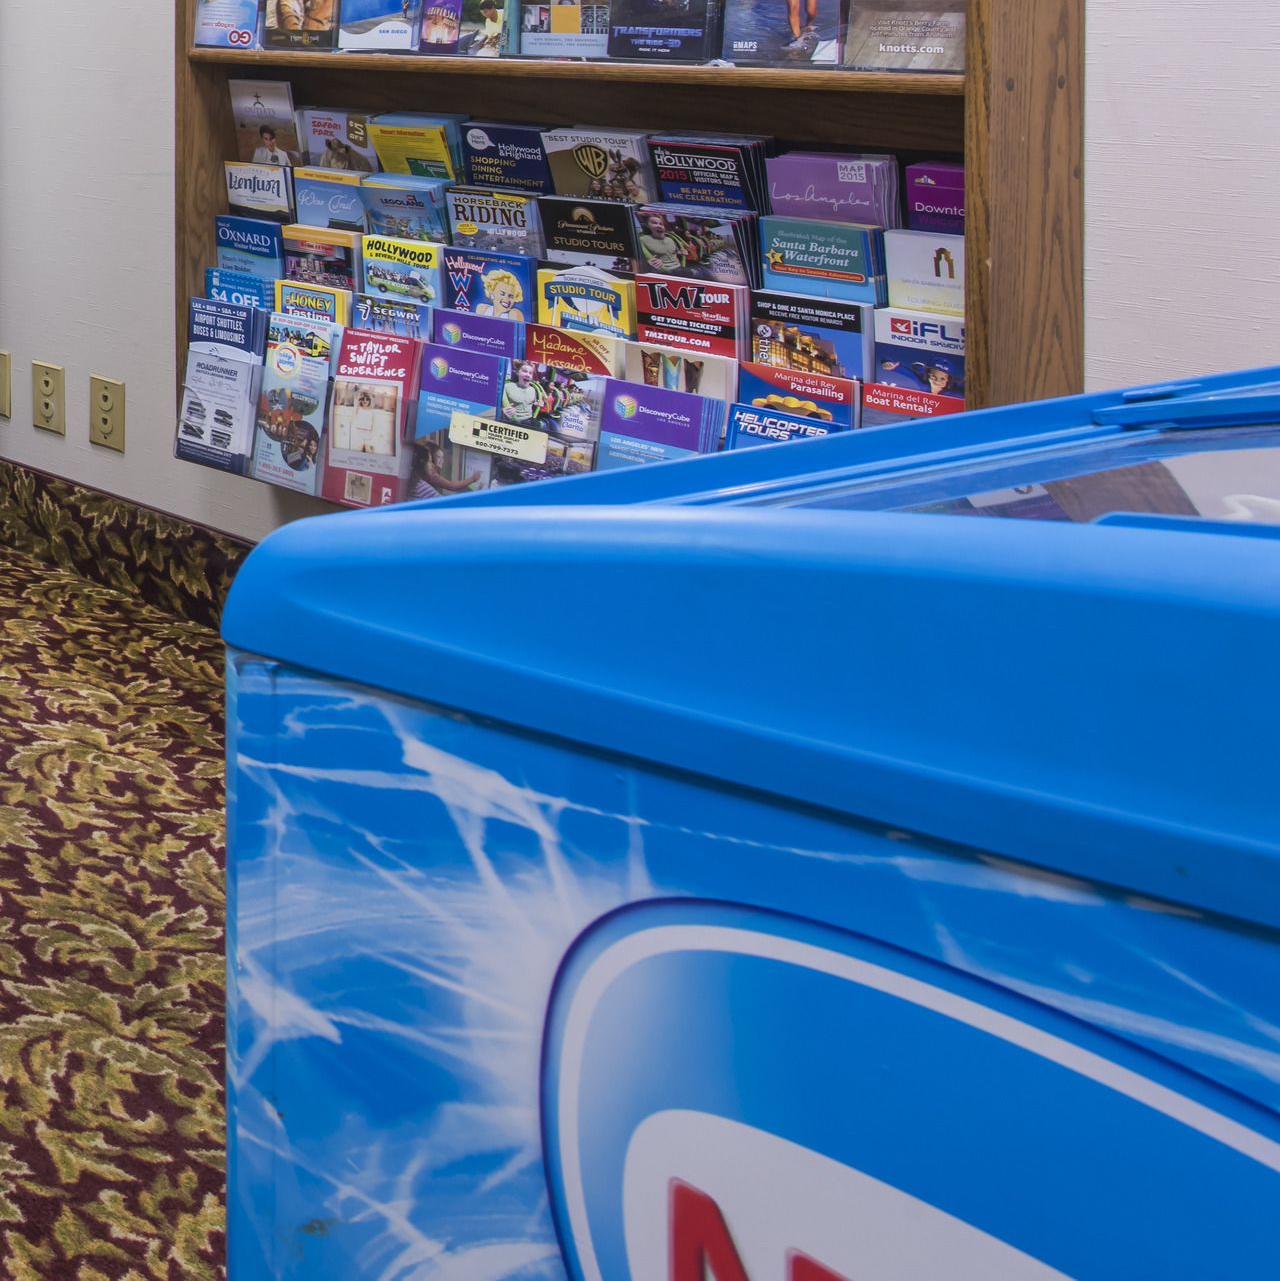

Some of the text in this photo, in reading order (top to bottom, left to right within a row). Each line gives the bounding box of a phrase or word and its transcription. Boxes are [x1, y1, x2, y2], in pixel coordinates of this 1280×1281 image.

[470, 156, 516, 167] SHOPPING
[472, 165, 503, 175] DINING
[655, 153, 736, 171] HOLLYWOOD
[839, 165, 864, 173] MAP
[473, 173, 544, 188] ENTERTAINMENT
[660, 169, 688, 180] 2015
[839, 173, 865, 181] 2015
[453, 203, 527, 227] RIDING
[219, 228, 270, 247] OXNARD
[553, 236, 624, 252] STUDIO TOURS
[367, 240, 433, 264] HOLLYWOOD
[772, 238, 858, 257] Santa Barbara
[783, 250, 850, 267] Waterfront
[289, 293, 333, 311] HONEY
[550, 285, 616, 303] STUDIO TOUR
[373, 307, 421, 321] SEGWAY
[644, 330, 711, 347] TMZTOUR.COM
[350, 353, 388, 366] SWIFT
[791, 383, 844, 401] Parasailing
[866, 395, 933, 414] Boat Rentals
[638, 405, 691, 422] DiscoveryCube
[734, 411, 828, 436] HELICOPTER
[488, 424, 529, 441] CERTIFIED
